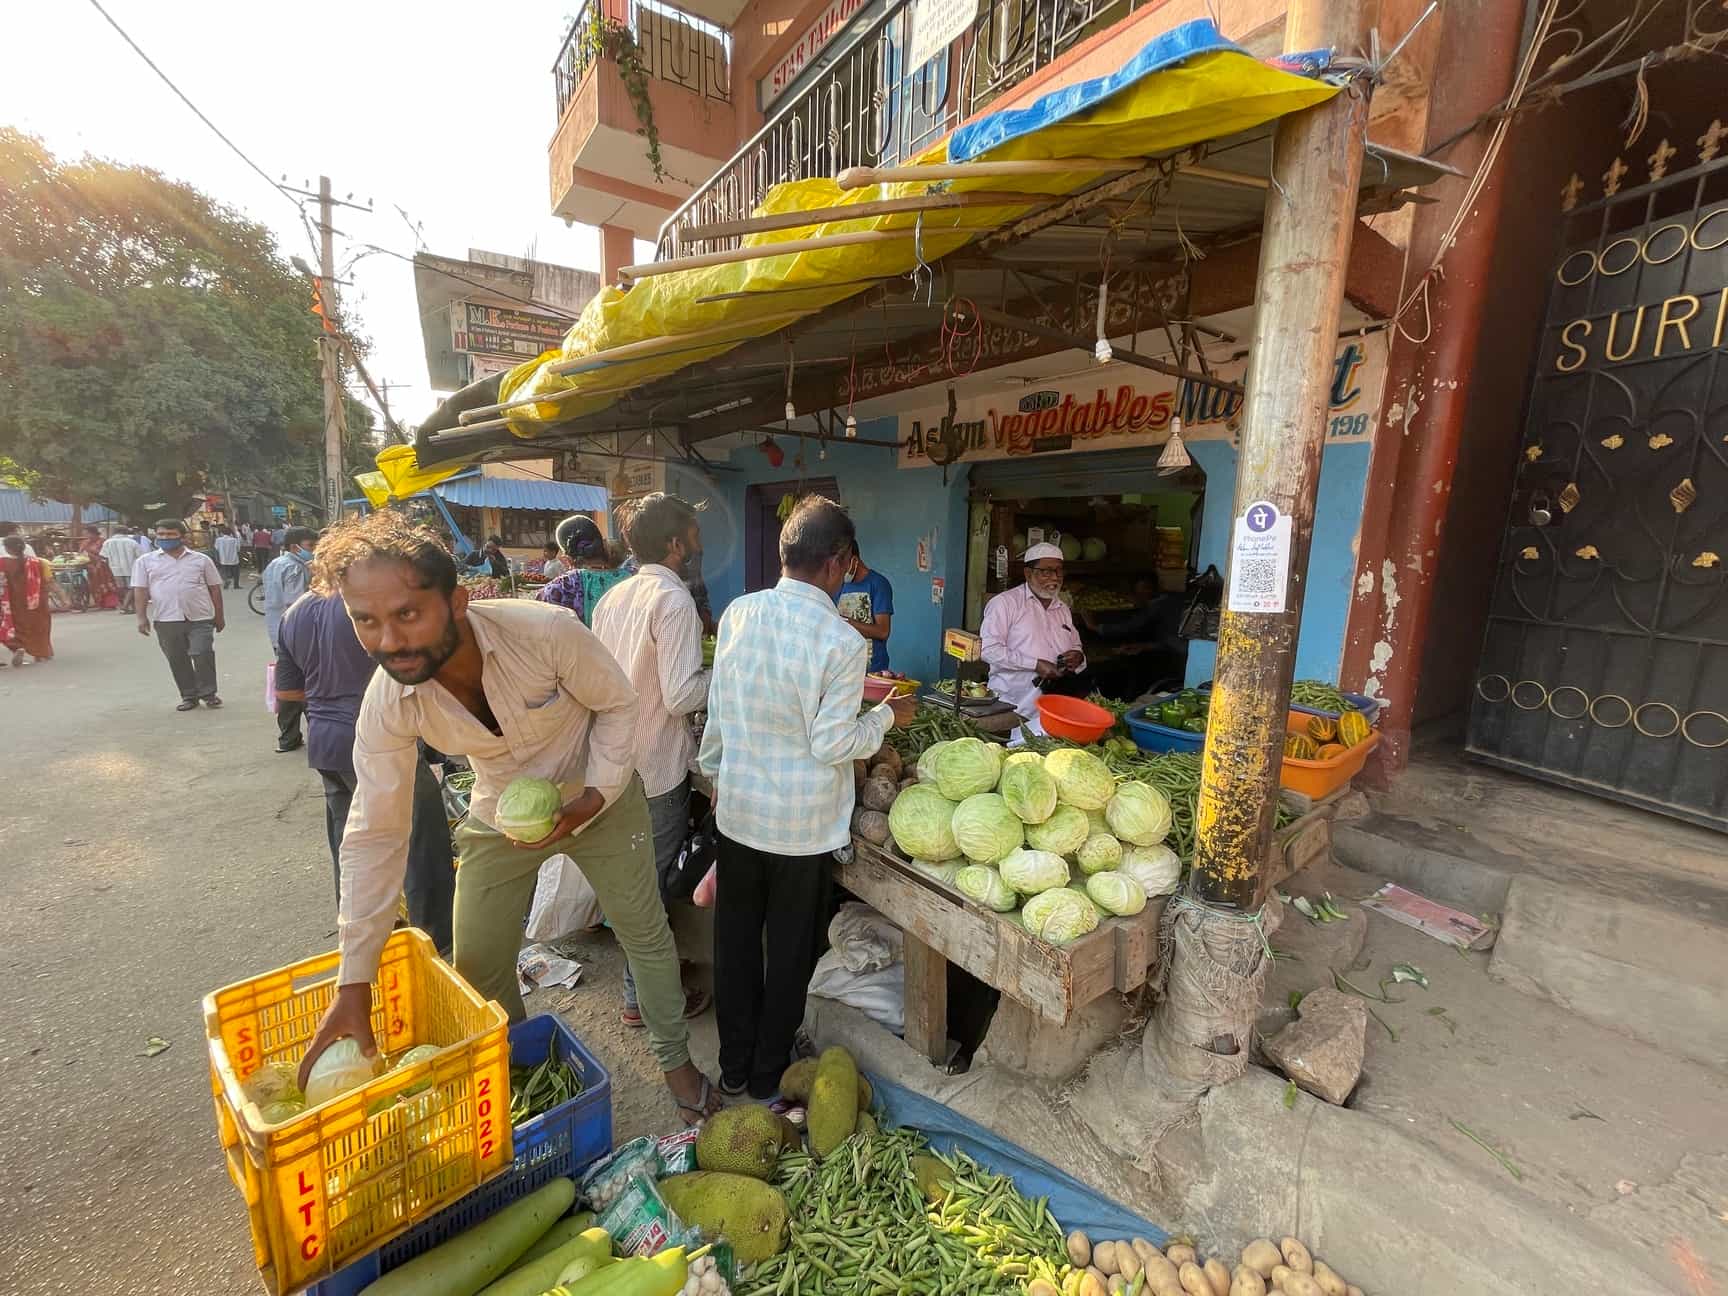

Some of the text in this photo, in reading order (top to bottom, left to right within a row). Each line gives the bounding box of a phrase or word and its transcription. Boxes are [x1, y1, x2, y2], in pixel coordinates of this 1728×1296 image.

[773, 52, 805, 95] STAR
[1556, 287, 1728, 372] SURI
[988, 385, 1174, 456] Vegetables
[478, 1078, 494, 1160] 2022
[297, 1171, 320, 1261] LTC
